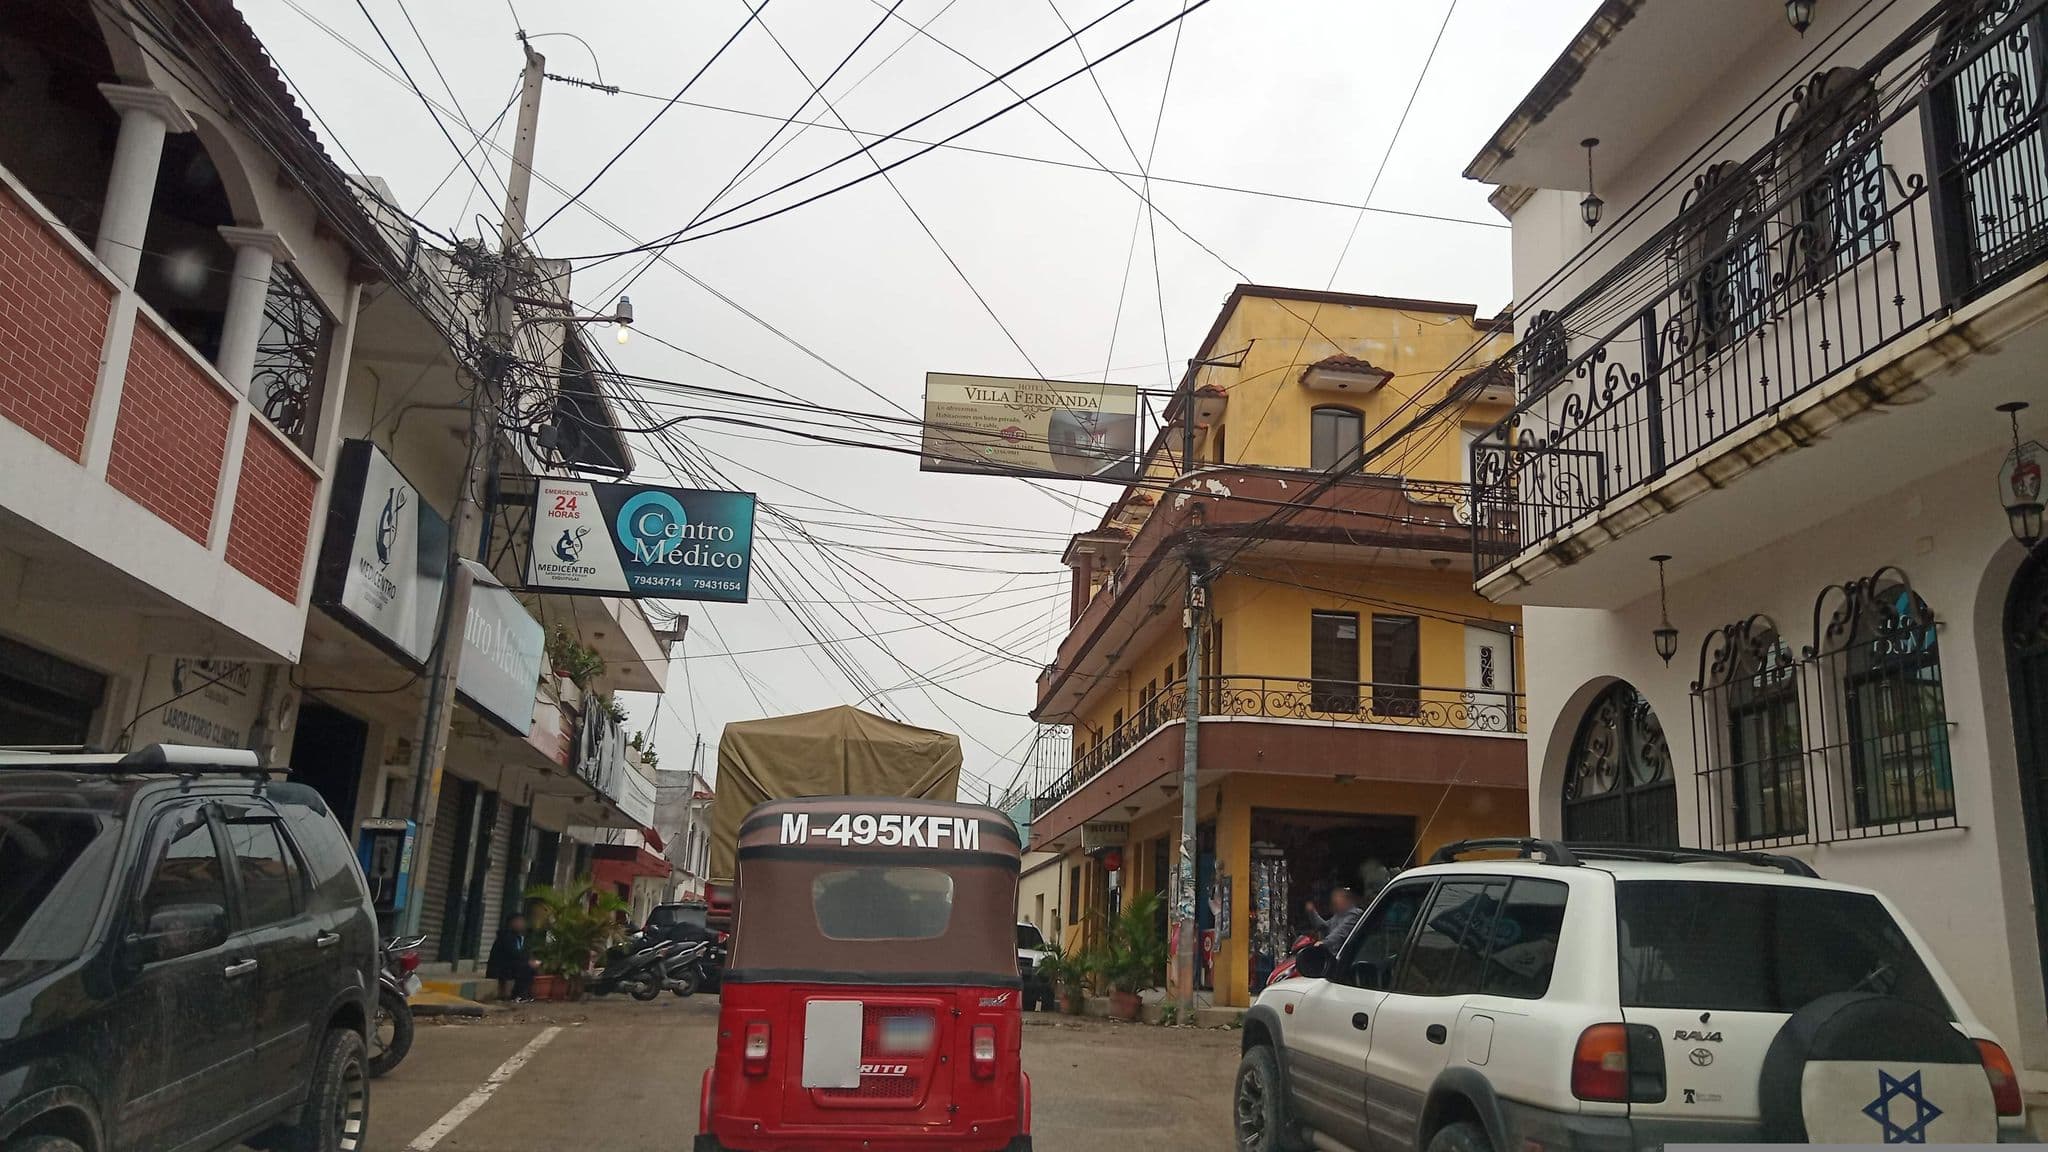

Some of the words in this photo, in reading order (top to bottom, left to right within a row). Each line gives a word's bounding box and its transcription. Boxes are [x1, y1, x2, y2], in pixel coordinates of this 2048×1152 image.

[1017, 383, 1045, 392] HOTEL
[965, 387, 1010, 404] VILLA
[1013, 390, 1099, 409] FERNANDA
[554, 496, 578, 512] 24
[548, 510, 581, 520] HORAS
[638, 512, 734, 543] Centro
[630, 537, 743, 570] Médico
[537, 563, 596, 576] MEDICENTRO
[359, 556, 397, 601] MEDICENTRO
[634, 576, 682, 587] 79434714
[693, 579, 741, 591] 79431654
[162, 706, 213, 740] LABORATORIO
[780, 813, 979, 851] M-495KFM
[1673, 1030, 1723, 1042] RAV4
[859, 1064, 908, 1074] RITO
